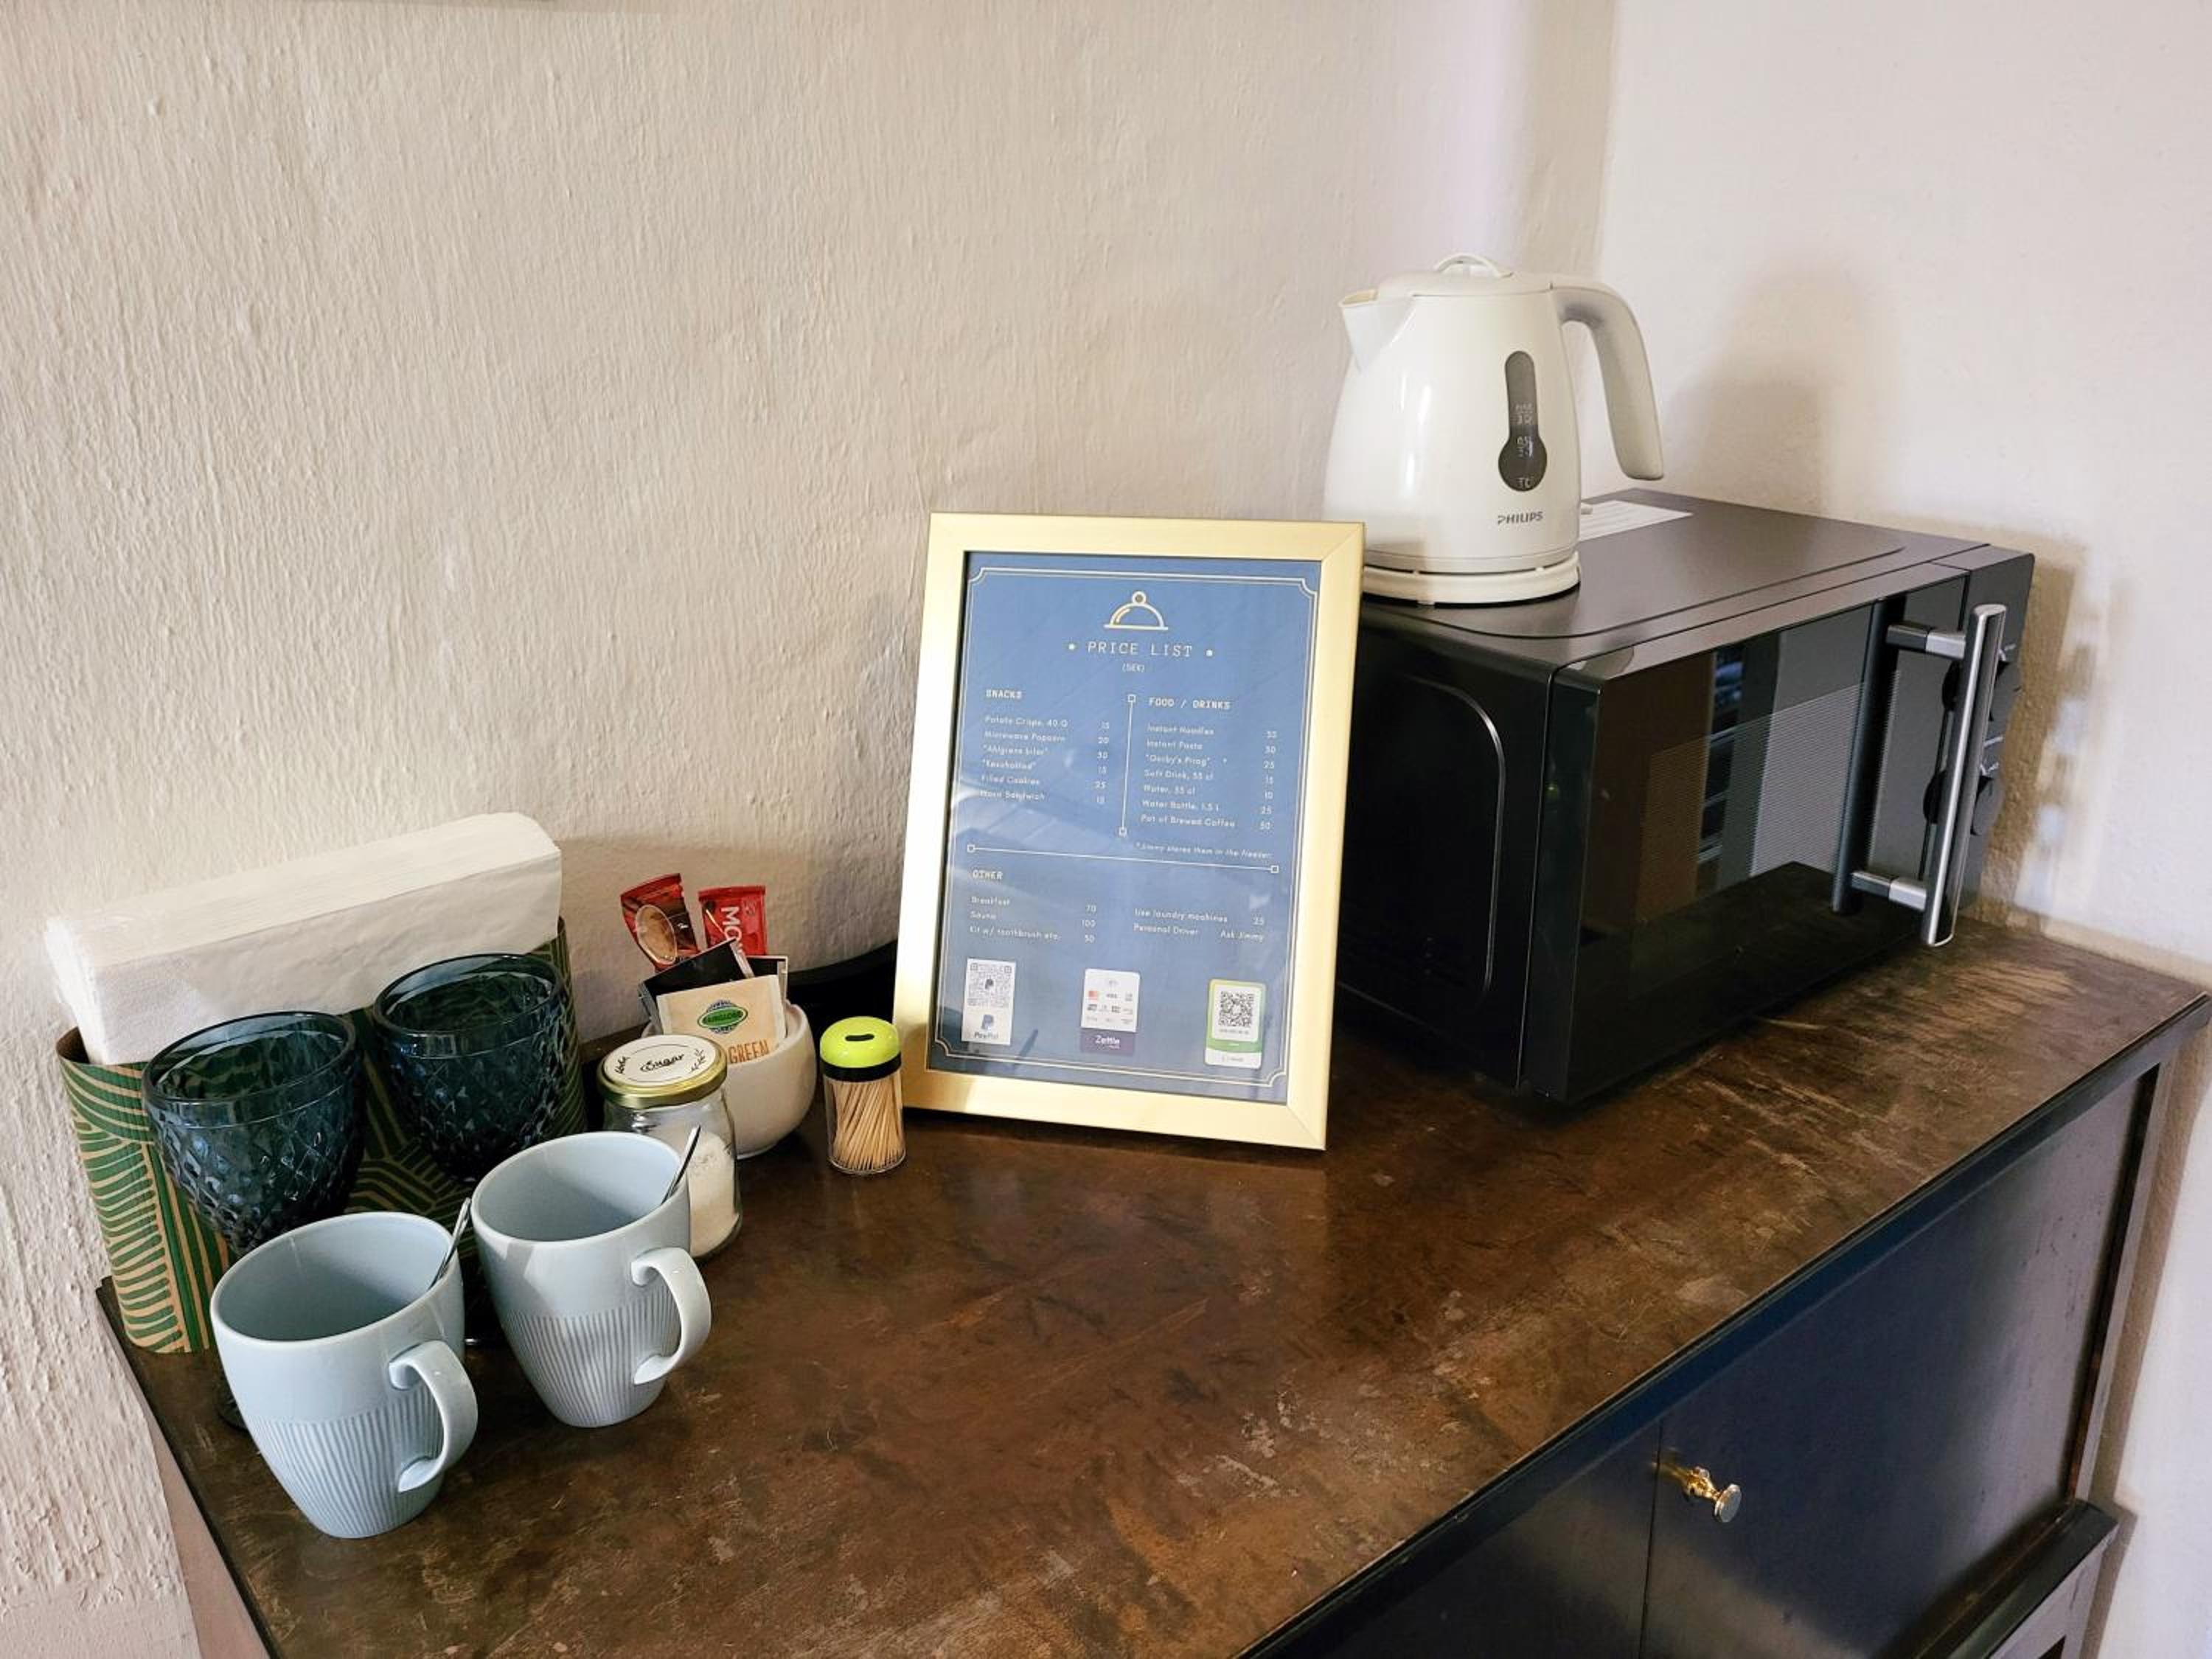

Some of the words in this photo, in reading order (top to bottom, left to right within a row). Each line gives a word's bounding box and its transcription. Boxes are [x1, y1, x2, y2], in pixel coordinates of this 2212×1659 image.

[1498, 511, 1543, 525] PHILIPS
[1087, 641, 1138, 655] PRICE
[1151, 643, 1192, 657] LIST
[986, 689, 1023, 699] SNACKS
[1149, 697, 1175, 708] FOOD
[1180, 700, 1186, 709] /
[1192, 700, 1231, 710] DRINKS
[1141, 813, 1156, 823] Pot
[973, 869, 1003, 880] OTHER
[1152, 909, 1185, 921] laundry
[1188, 912, 1228, 923] machines
[1133, 922, 1170, 933] Personal
[728, 1039, 769, 1064] GREEN
[640, 1053, 685, 1072] Sugar
